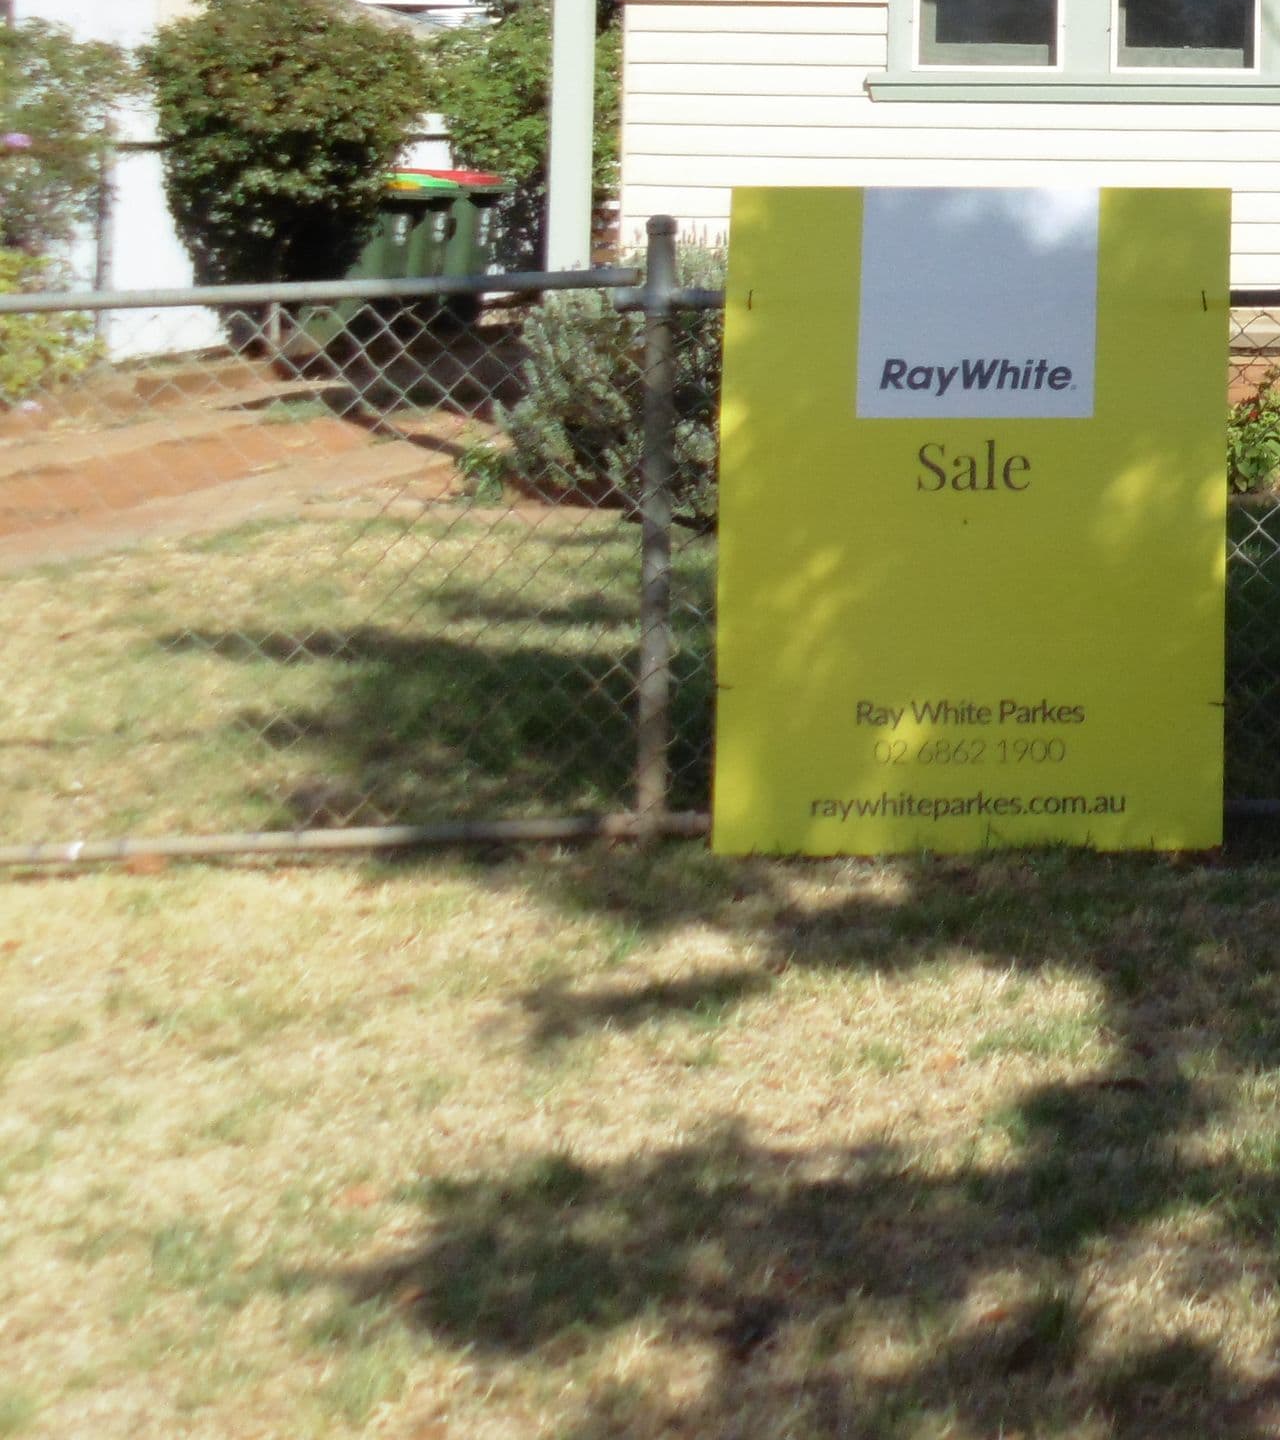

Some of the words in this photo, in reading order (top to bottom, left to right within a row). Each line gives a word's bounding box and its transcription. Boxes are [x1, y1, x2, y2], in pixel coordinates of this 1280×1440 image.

[917, 439, 1031, 492] Sale
[856, 699, 904, 729] Ray
[911, 699, 992, 726] White
[998, 698, 1086, 726] Parkes
[873, 738, 908, 765] 02
[916, 737, 986, 765] 6862
[997, 736, 1067, 765] 1900
[809, 791, 1126, 822] raywhiteparkes.com.au
